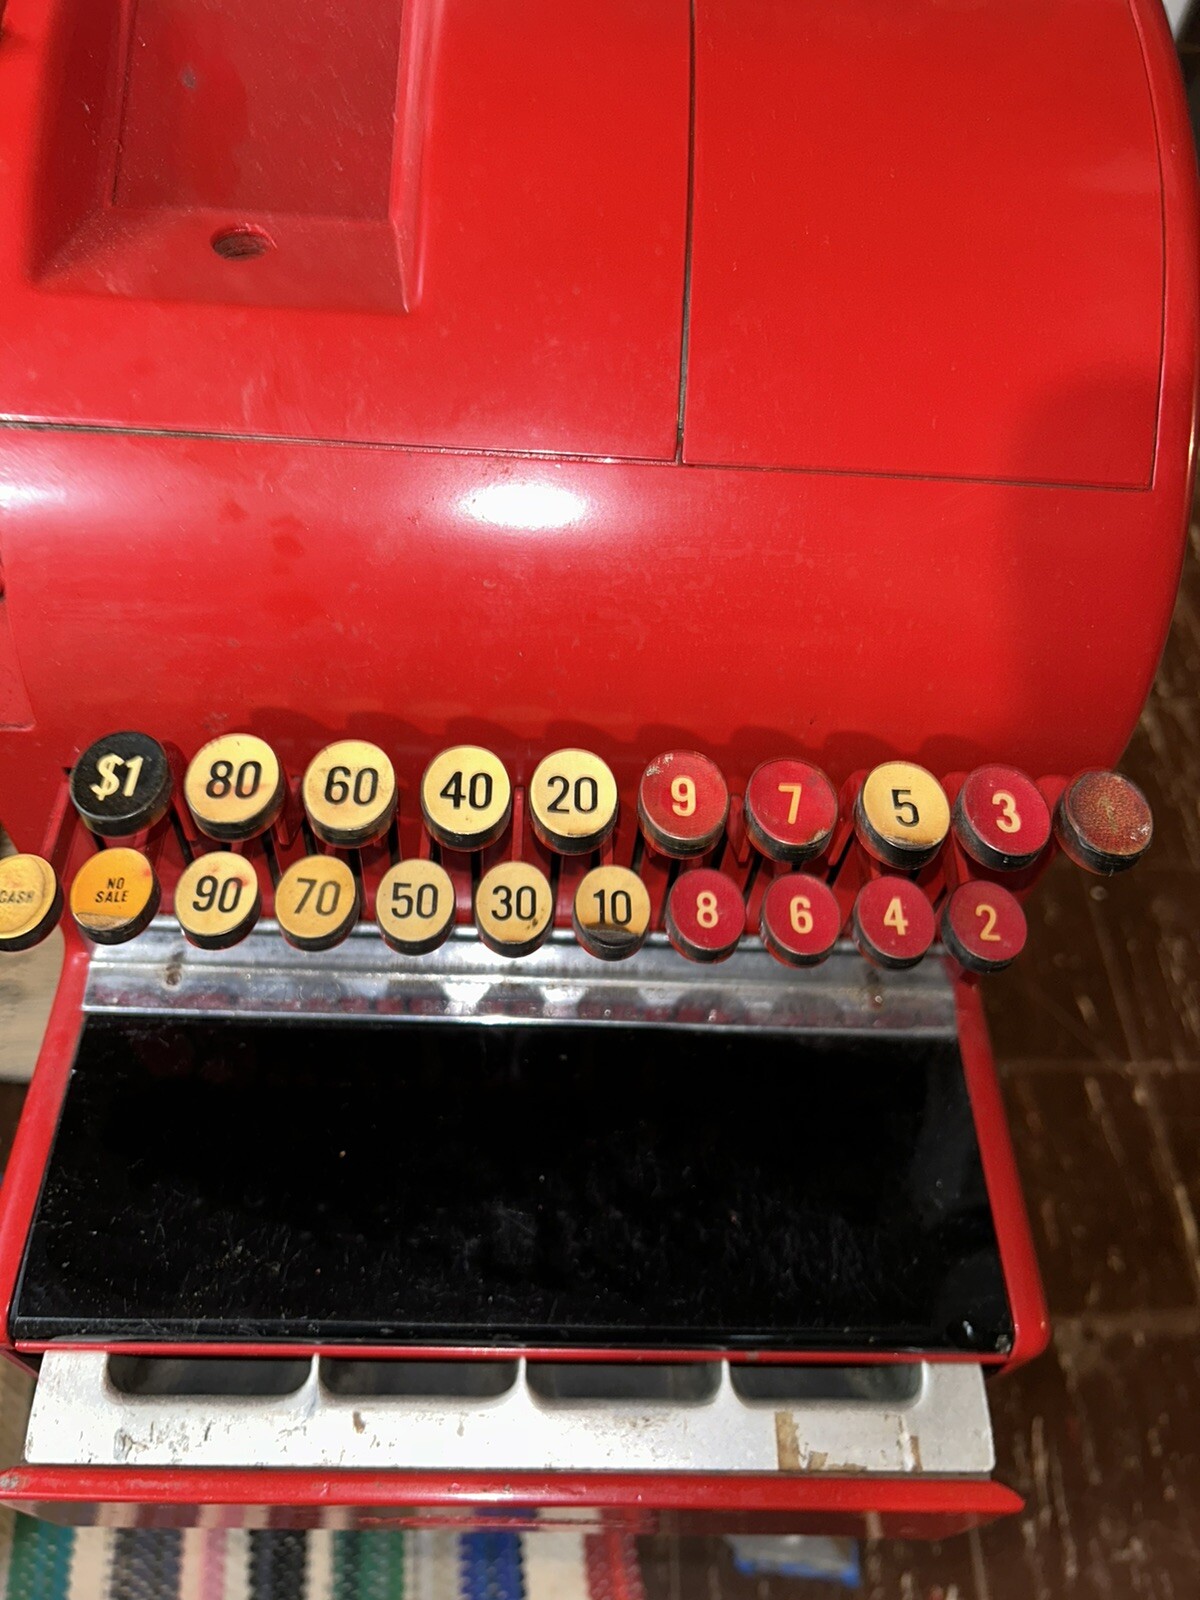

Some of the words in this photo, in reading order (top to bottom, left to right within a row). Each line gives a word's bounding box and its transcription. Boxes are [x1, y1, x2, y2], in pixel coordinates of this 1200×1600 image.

[90, 753, 144, 801] $1
[206, 760, 262, 800] 80
[324, 766, 379, 806] 60
[440, 771, 493, 810] 40
[547, 775, 598, 814] 20
[671, 775, 697, 817] 9
[777, 783, 802, 825] 7
[891, 789, 920, 828] 5
[991, 792, 1022, 834] 3
[0, 890, 35, 904] CASH
[95, 890, 129, 904] SALE
[106, 877, 126, 890] NO
[192, 875, 244, 913] 90
[294, 877, 341, 916] 70
[391, 882, 439, 920] 50
[491, 885, 537, 921] 30
[593, 888, 632, 927] 10
[696, 891, 719, 929] 8
[789, 895, 814, 935] 6
[883, 898, 909, 936] 4
[974, 904, 1001, 941] 2
